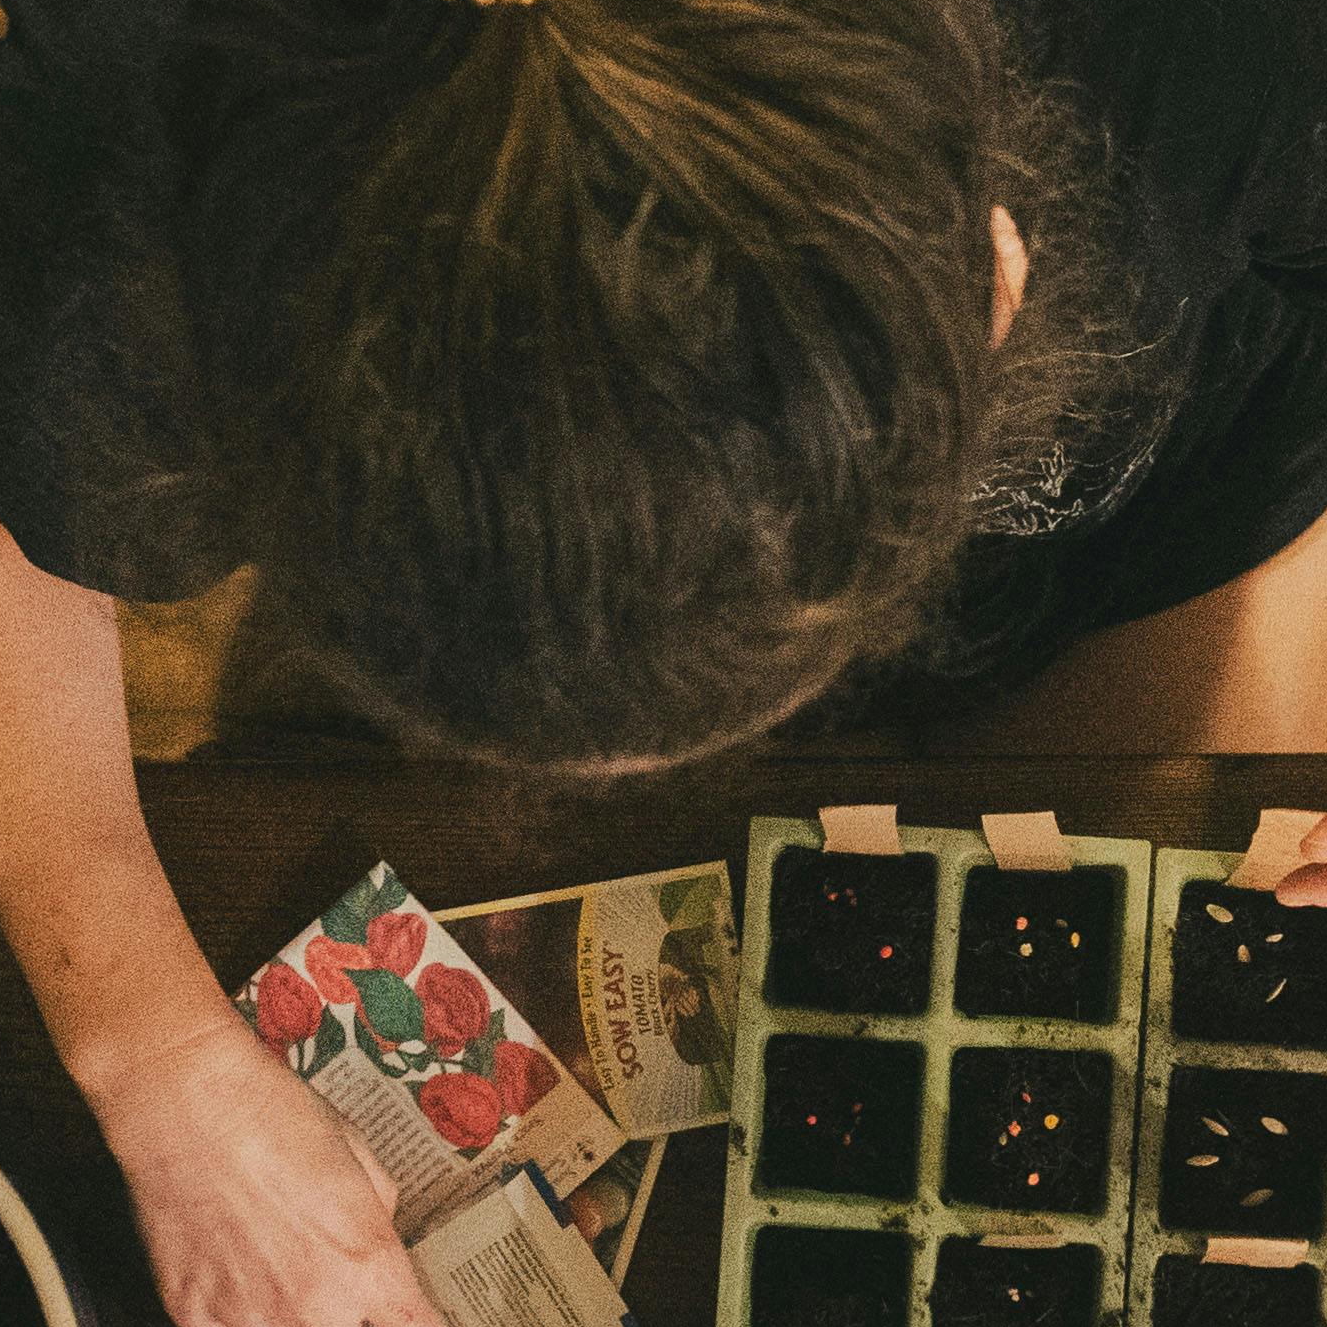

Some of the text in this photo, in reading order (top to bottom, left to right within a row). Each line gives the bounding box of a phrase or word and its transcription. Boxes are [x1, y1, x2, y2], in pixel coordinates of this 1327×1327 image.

[592, 944, 645, 1081] SOW EASY
[625, 971, 656, 1036] TOMATO
